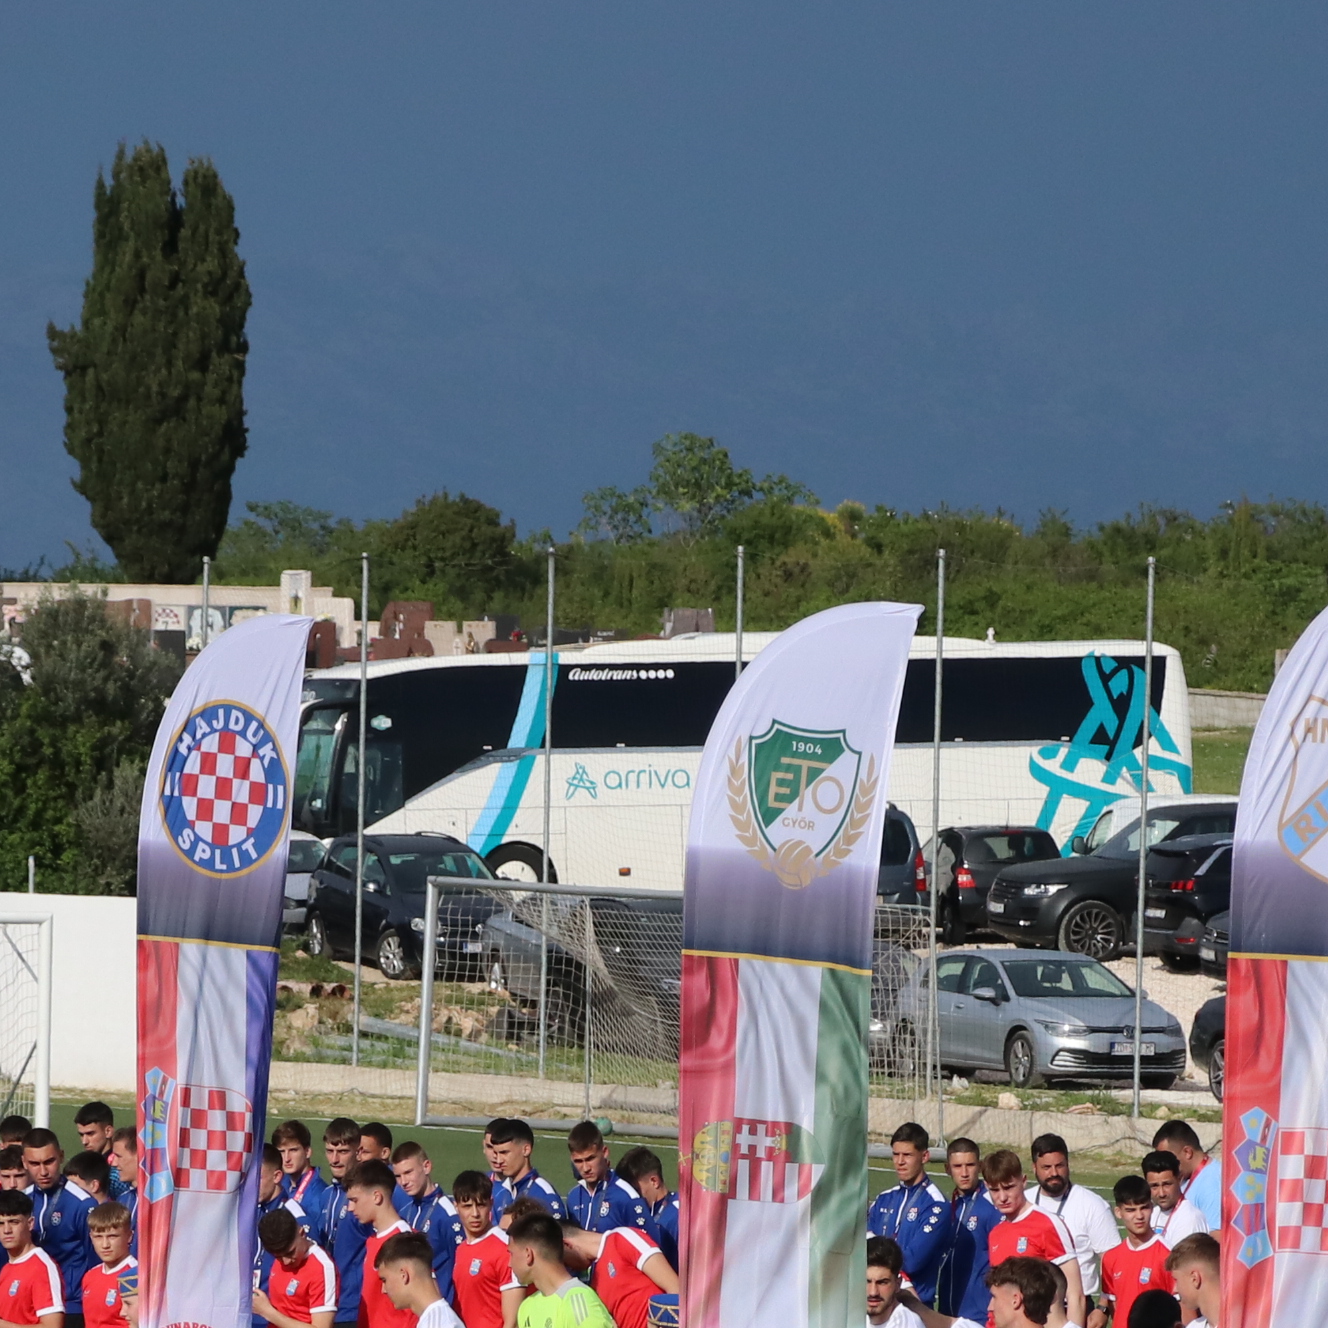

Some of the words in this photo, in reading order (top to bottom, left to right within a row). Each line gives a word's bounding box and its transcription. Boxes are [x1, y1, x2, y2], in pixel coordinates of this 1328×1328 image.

[176, 708, 278, 769] HAJDUK
[791, 741, 823, 755] 1904
[603, 763, 691, 790] arriva
[767, 757, 845, 814] ETO
[177, 827, 259, 870] SPLIT
